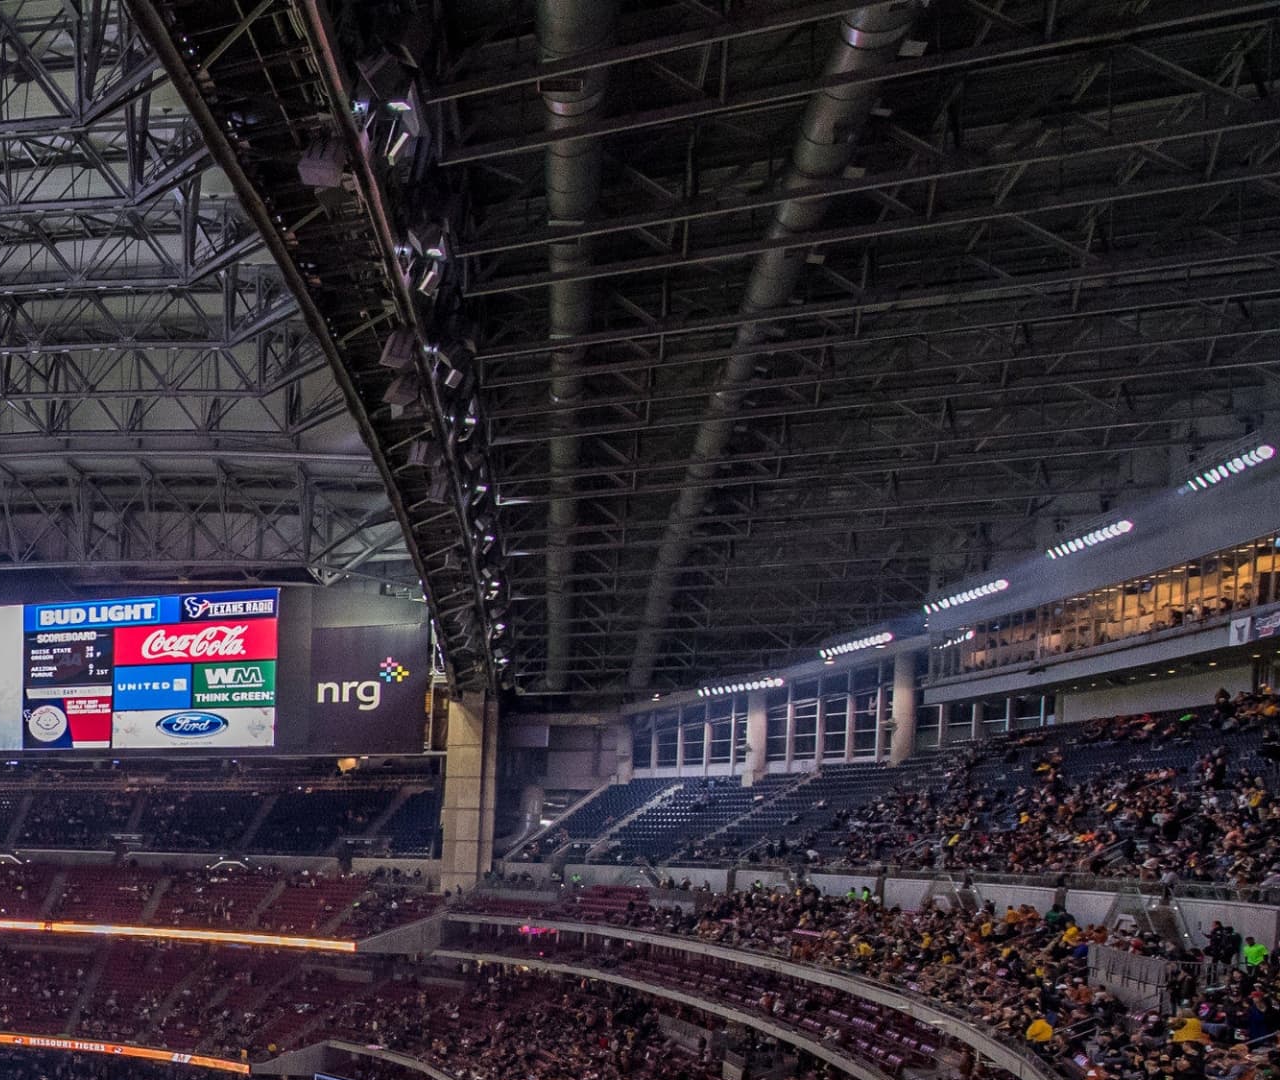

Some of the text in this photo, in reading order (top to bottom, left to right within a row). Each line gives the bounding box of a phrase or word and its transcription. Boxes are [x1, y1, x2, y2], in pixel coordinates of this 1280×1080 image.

[40, 603, 156, 626] BUD LIGHT
[208, 600, 274, 615] TEXANS RADIO
[36, 631, 97, 643] SCOREBOARD
[117, 682, 171, 692] UNITED
[194, 693, 230, 702] THINK
[316, 680, 381, 711] nrg
[171, 715, 211, 732] Ford
[29, 1036, 105, 1052] MISSOURI TIGERS
